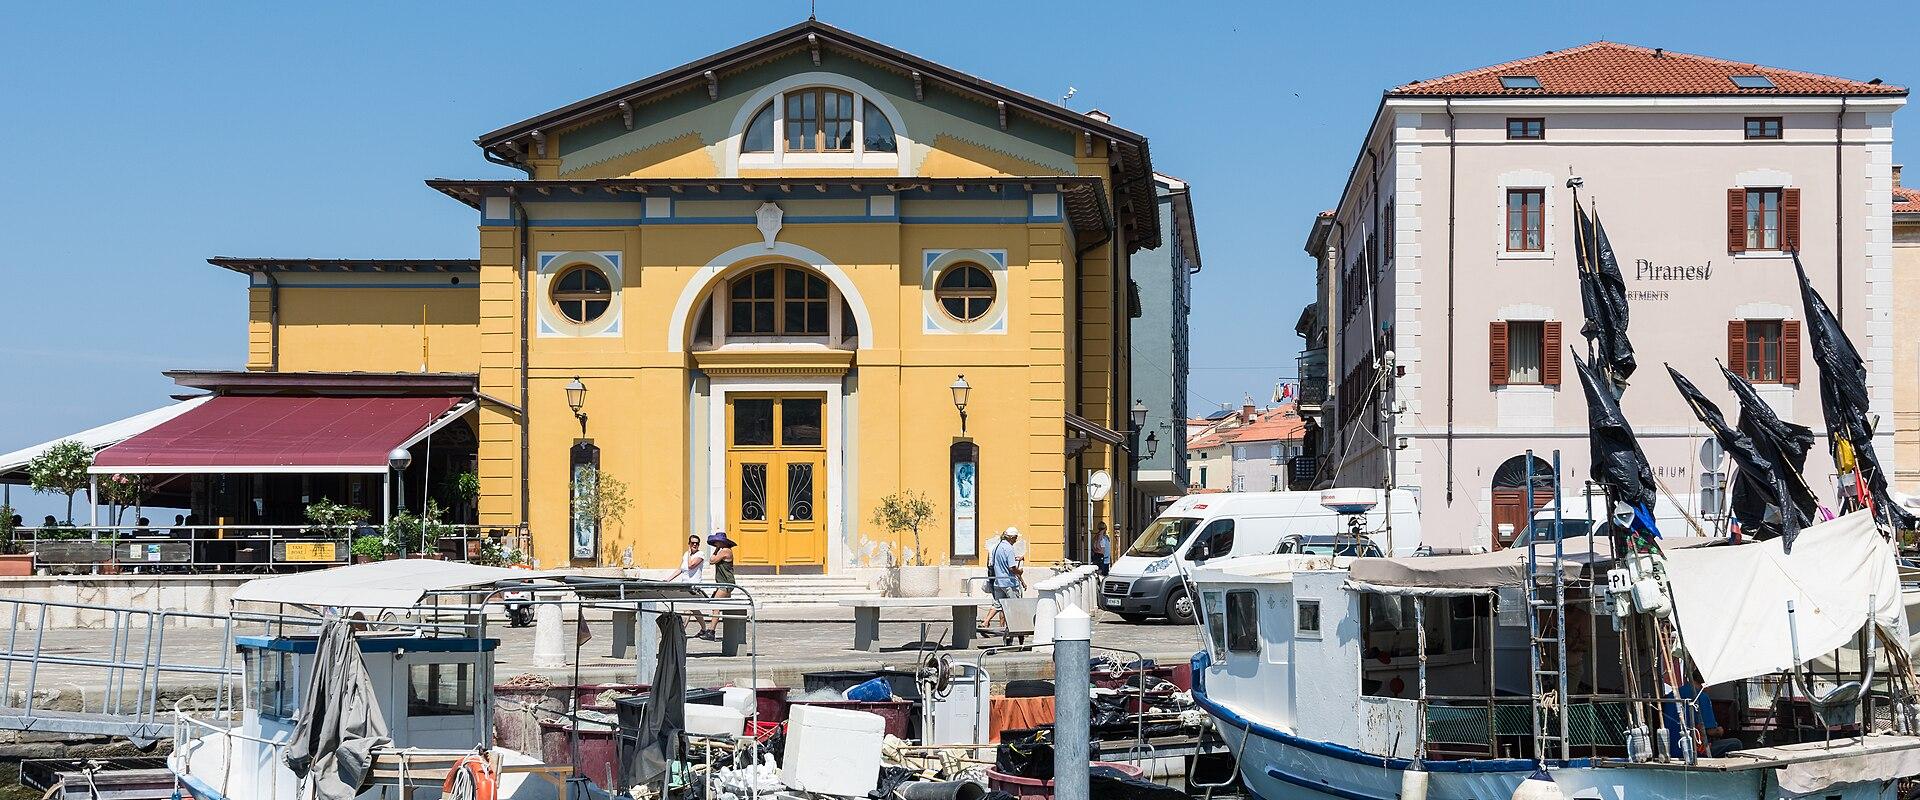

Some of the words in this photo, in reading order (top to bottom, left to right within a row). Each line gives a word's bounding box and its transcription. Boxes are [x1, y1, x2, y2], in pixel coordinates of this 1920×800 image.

[1634, 258, 1713, 281] Piranesi
[1627, 290, 1670, 301] RTMENTS
[1651, 466, 1685, 478] ARIUM
